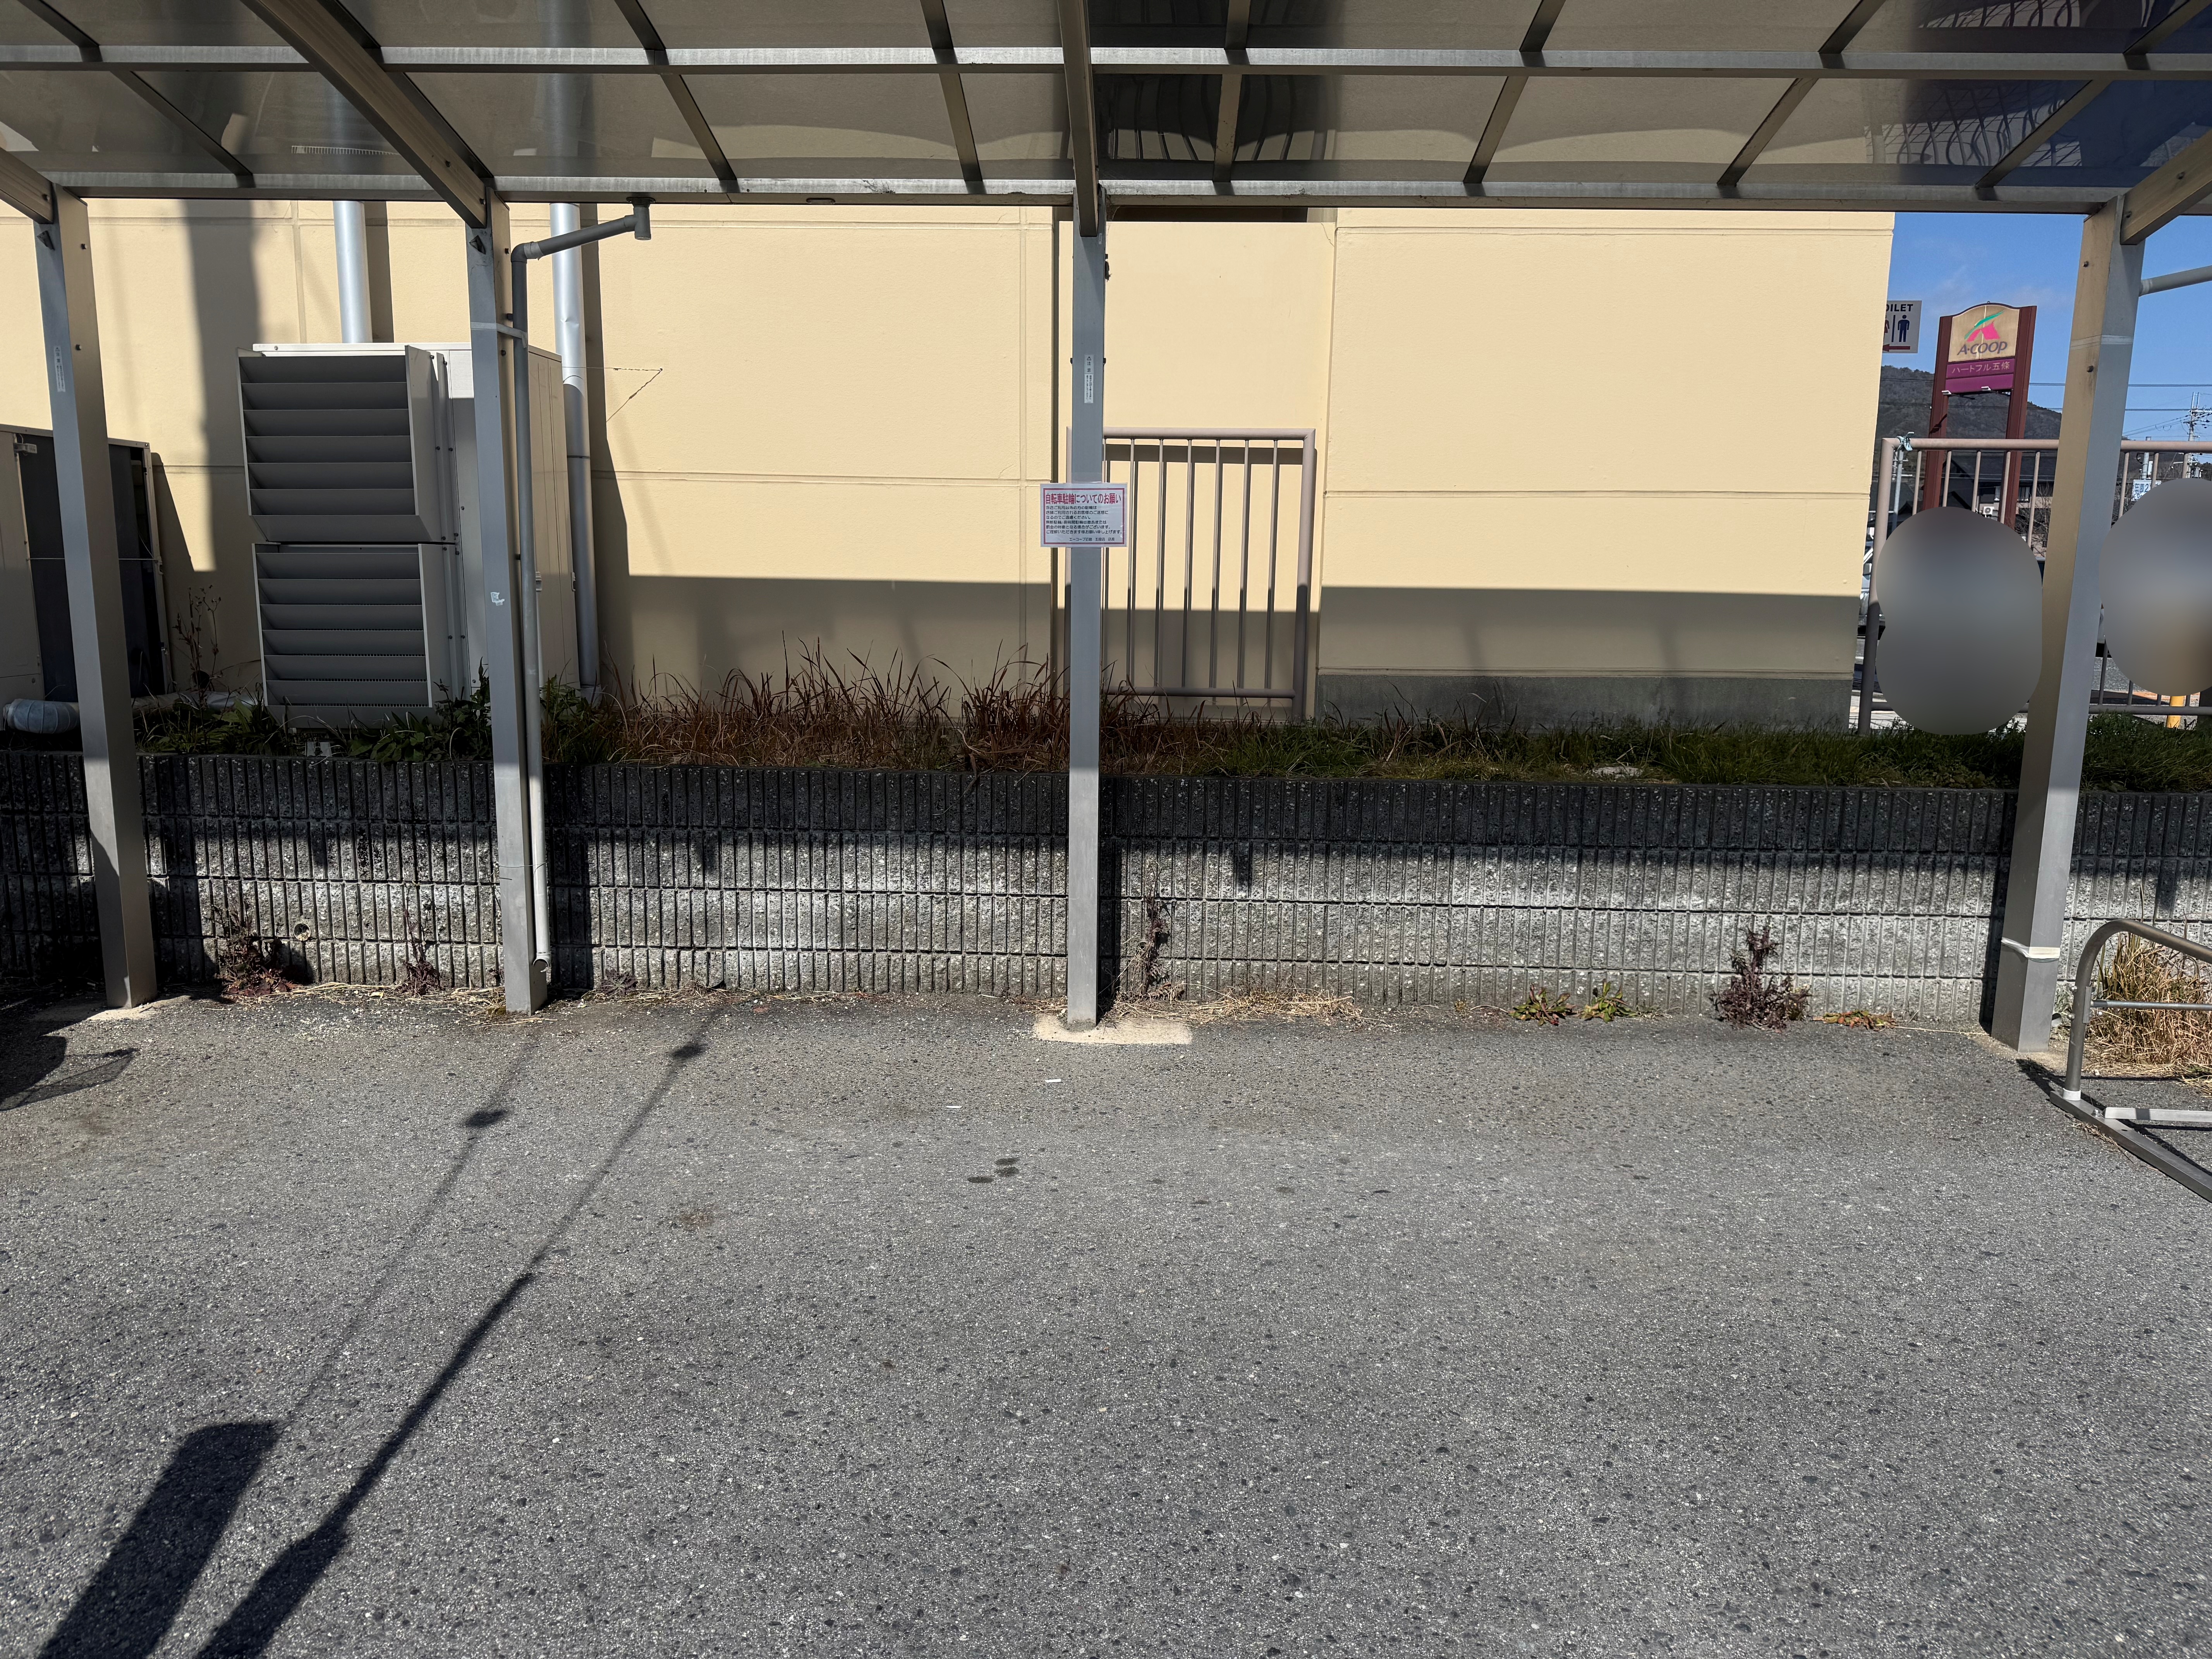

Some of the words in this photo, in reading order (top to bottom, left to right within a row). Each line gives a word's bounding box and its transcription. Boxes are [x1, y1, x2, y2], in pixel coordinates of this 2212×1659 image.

[1951, 361, 2010, 374] ハートフル五條
[1046, 493, 1121, 504] 自転車駐輪についてのお願い
